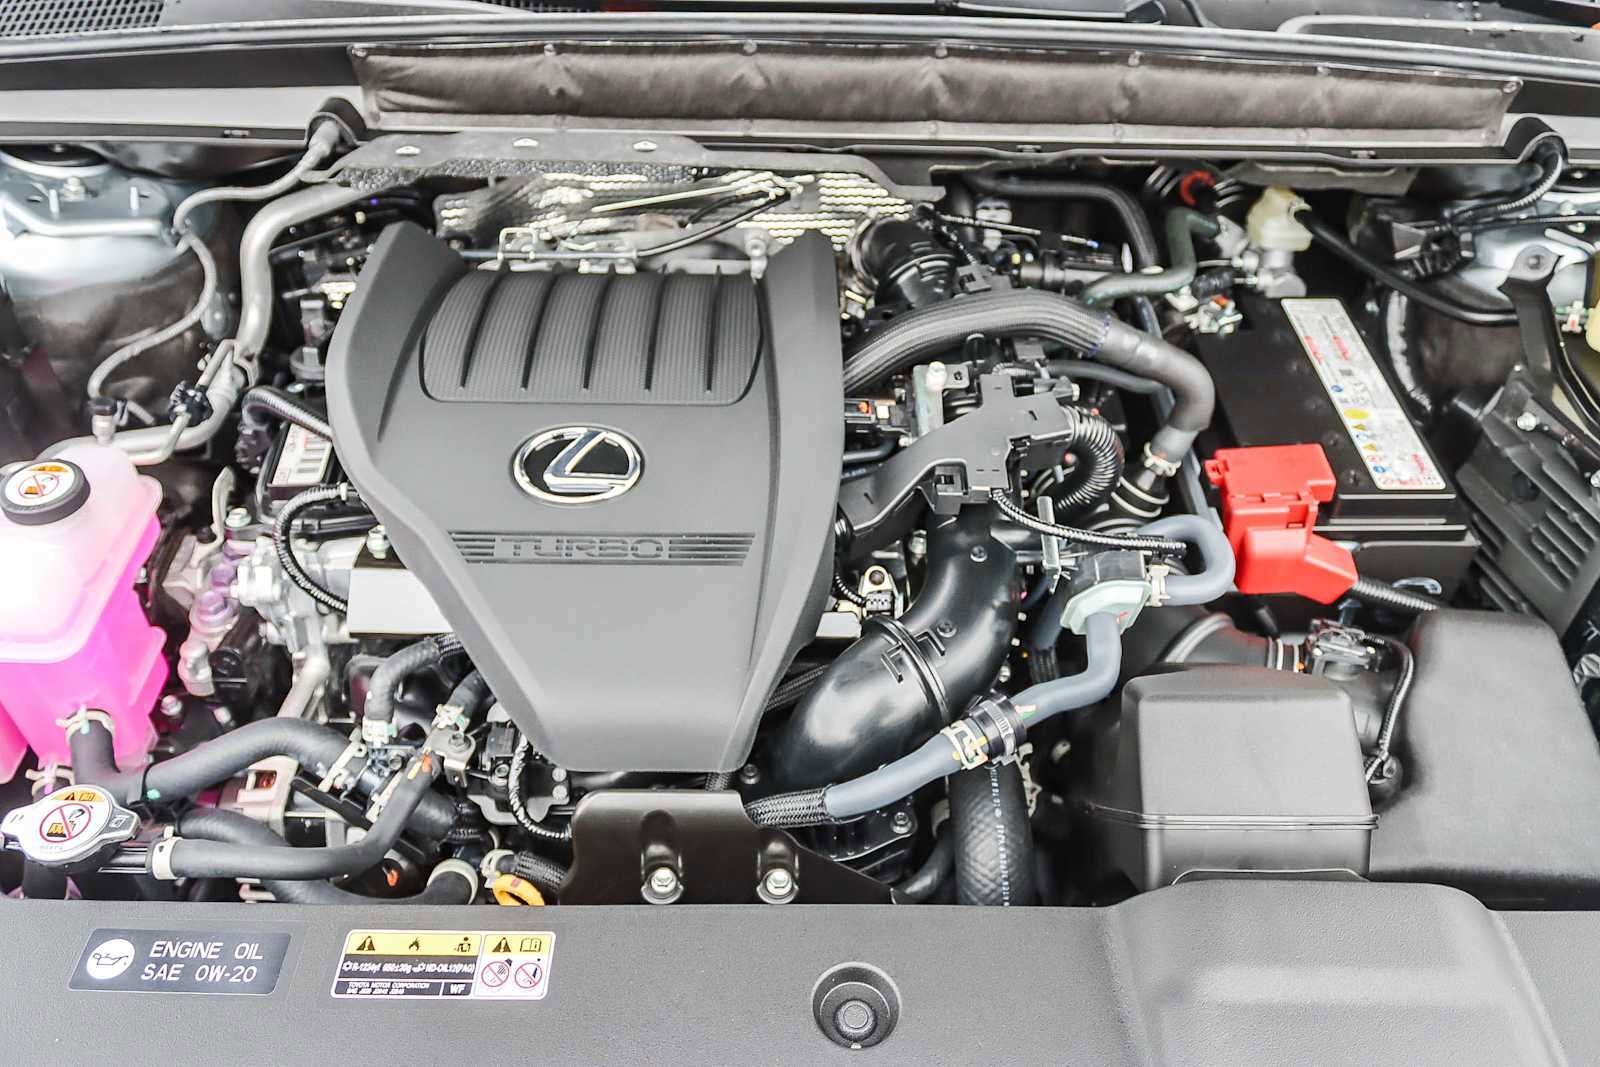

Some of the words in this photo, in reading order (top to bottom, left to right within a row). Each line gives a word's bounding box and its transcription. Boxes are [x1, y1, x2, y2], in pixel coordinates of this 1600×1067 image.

[500, 537, 664, 559] TURBO
[149, 940, 223, 959] ENGINE
[233, 943, 265, 960] OIL
[140, 964, 184, 981] SAE
[195, 965, 258, 983] 0W-20
[450, 983, 466, 995] WF
